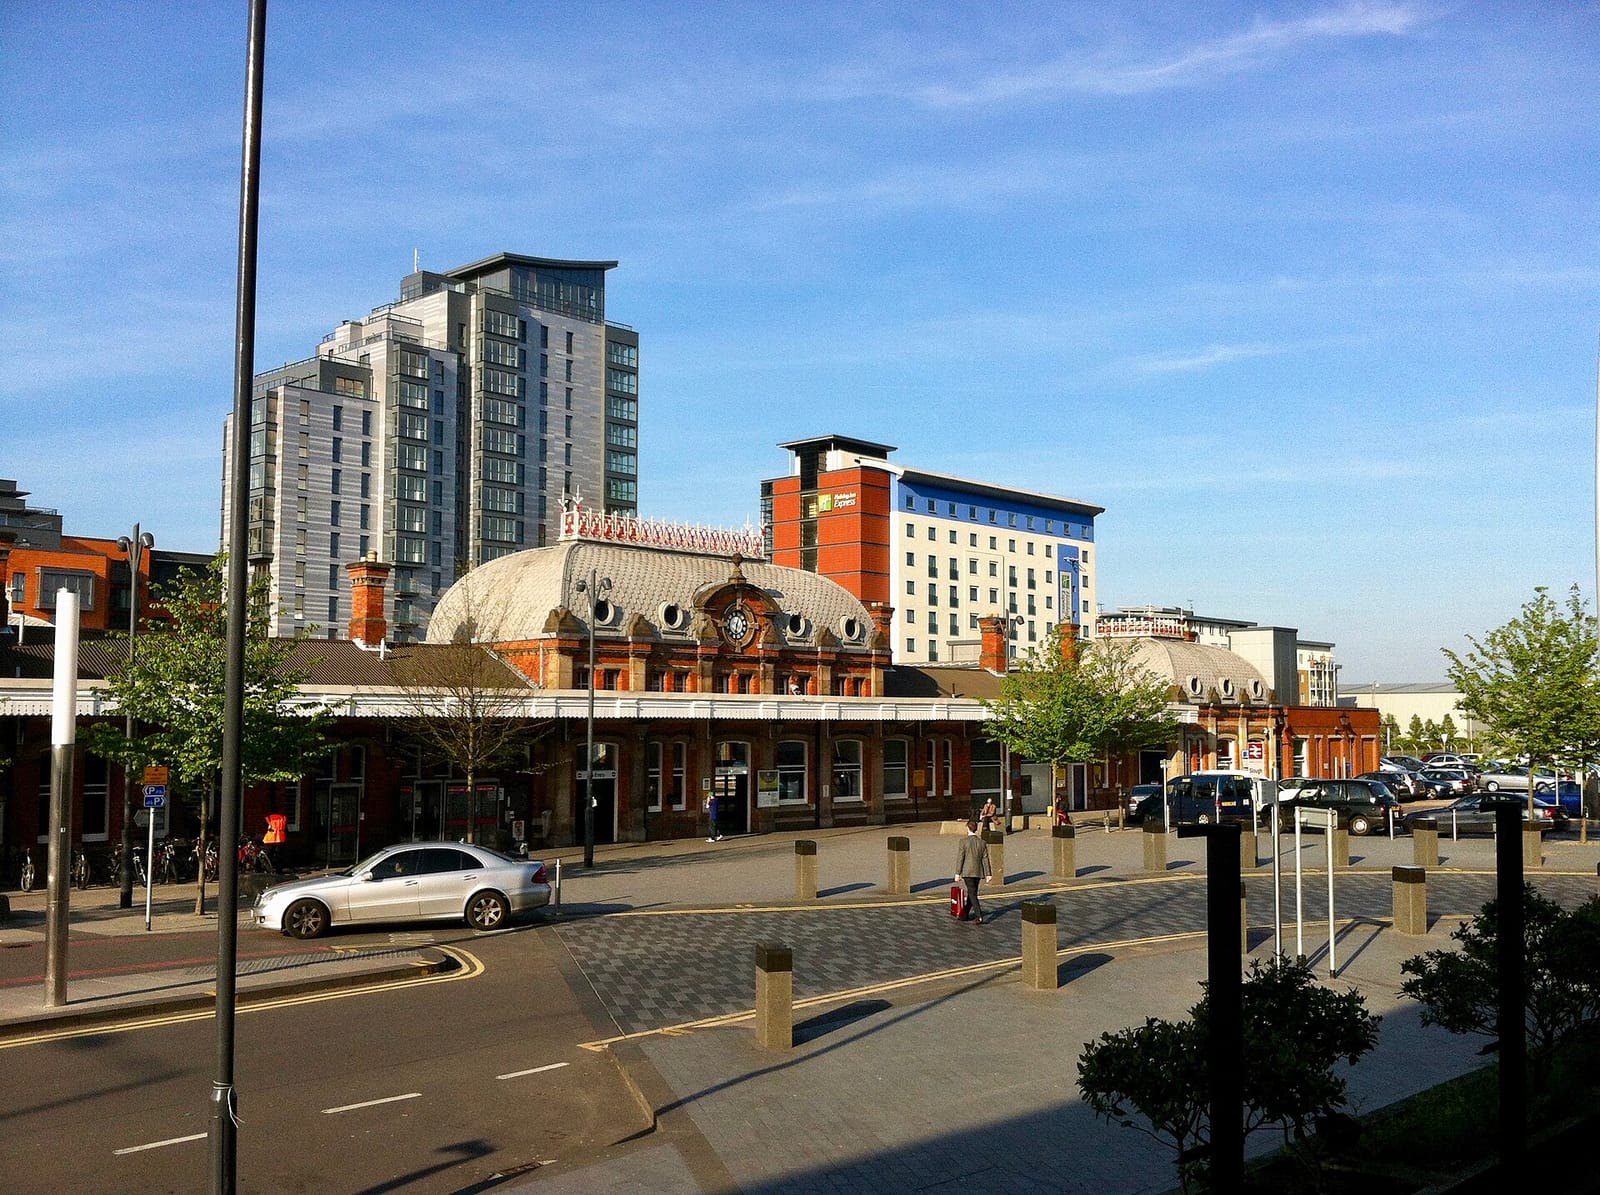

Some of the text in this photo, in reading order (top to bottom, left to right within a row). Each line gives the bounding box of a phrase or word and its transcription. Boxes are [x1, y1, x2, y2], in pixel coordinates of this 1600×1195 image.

[834, 498, 856, 509] Express
[148, 786, 156, 795] P
[153, 797, 160, 806] P
